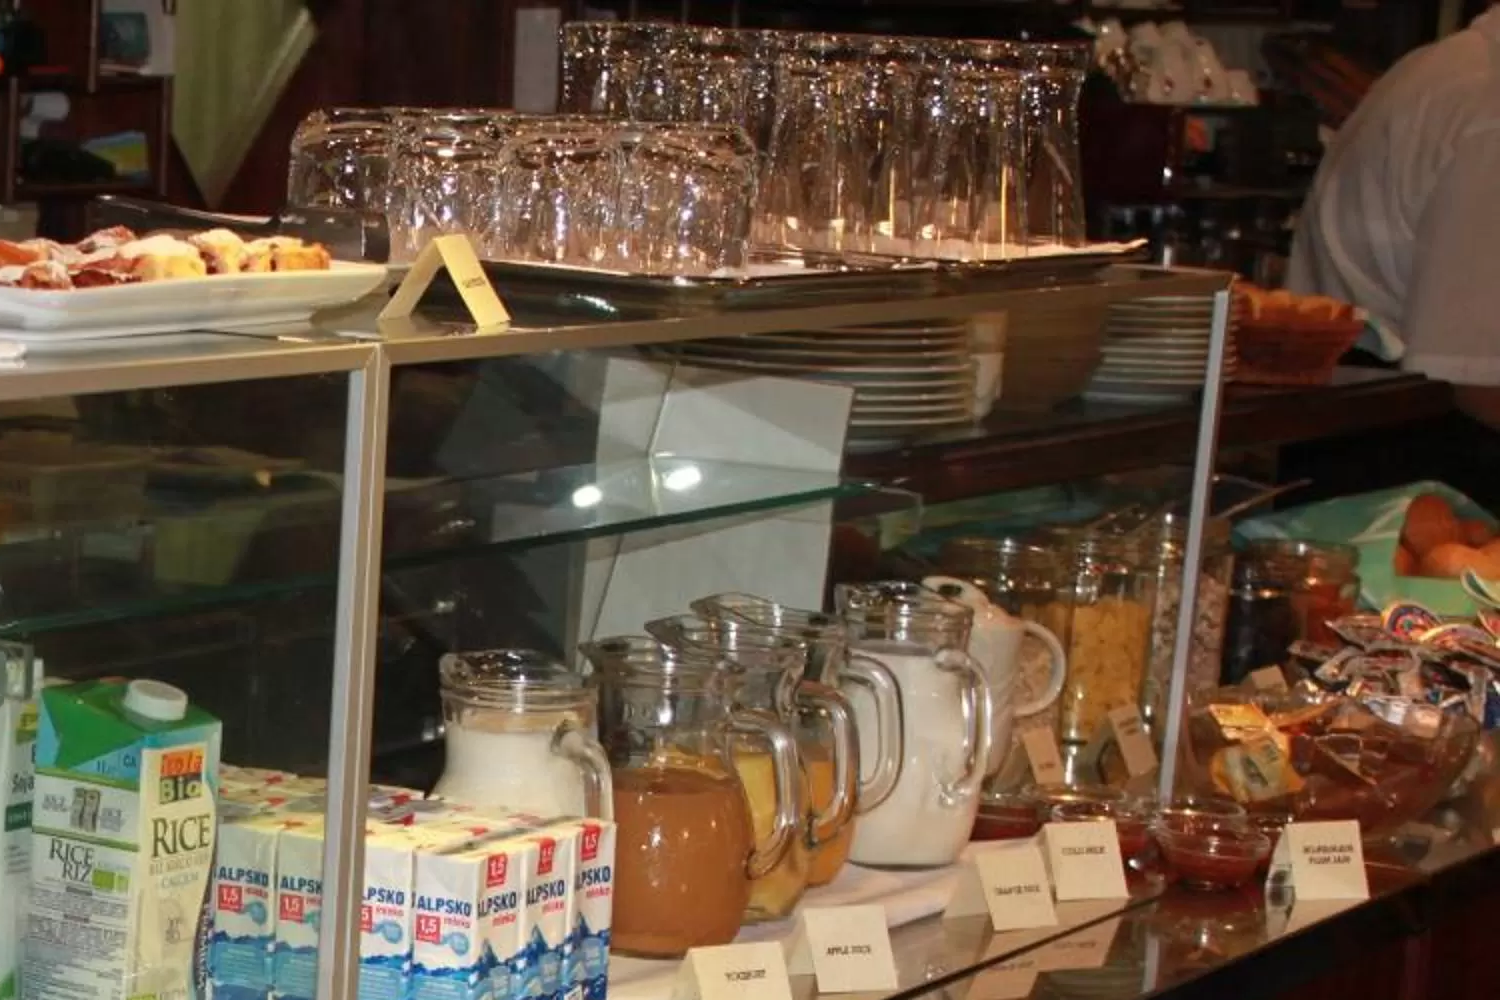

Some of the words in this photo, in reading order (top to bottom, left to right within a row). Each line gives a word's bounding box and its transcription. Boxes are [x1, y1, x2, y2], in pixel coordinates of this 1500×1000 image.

[160, 775, 203, 804] Bio
[151, 813, 211, 857] RICE
[50, 838, 95, 865] RICE
[218, 866, 270, 887] ALPSKO
[280, 875, 323, 893] ALPSK
[417, 895, 472, 917] ALPSKO
